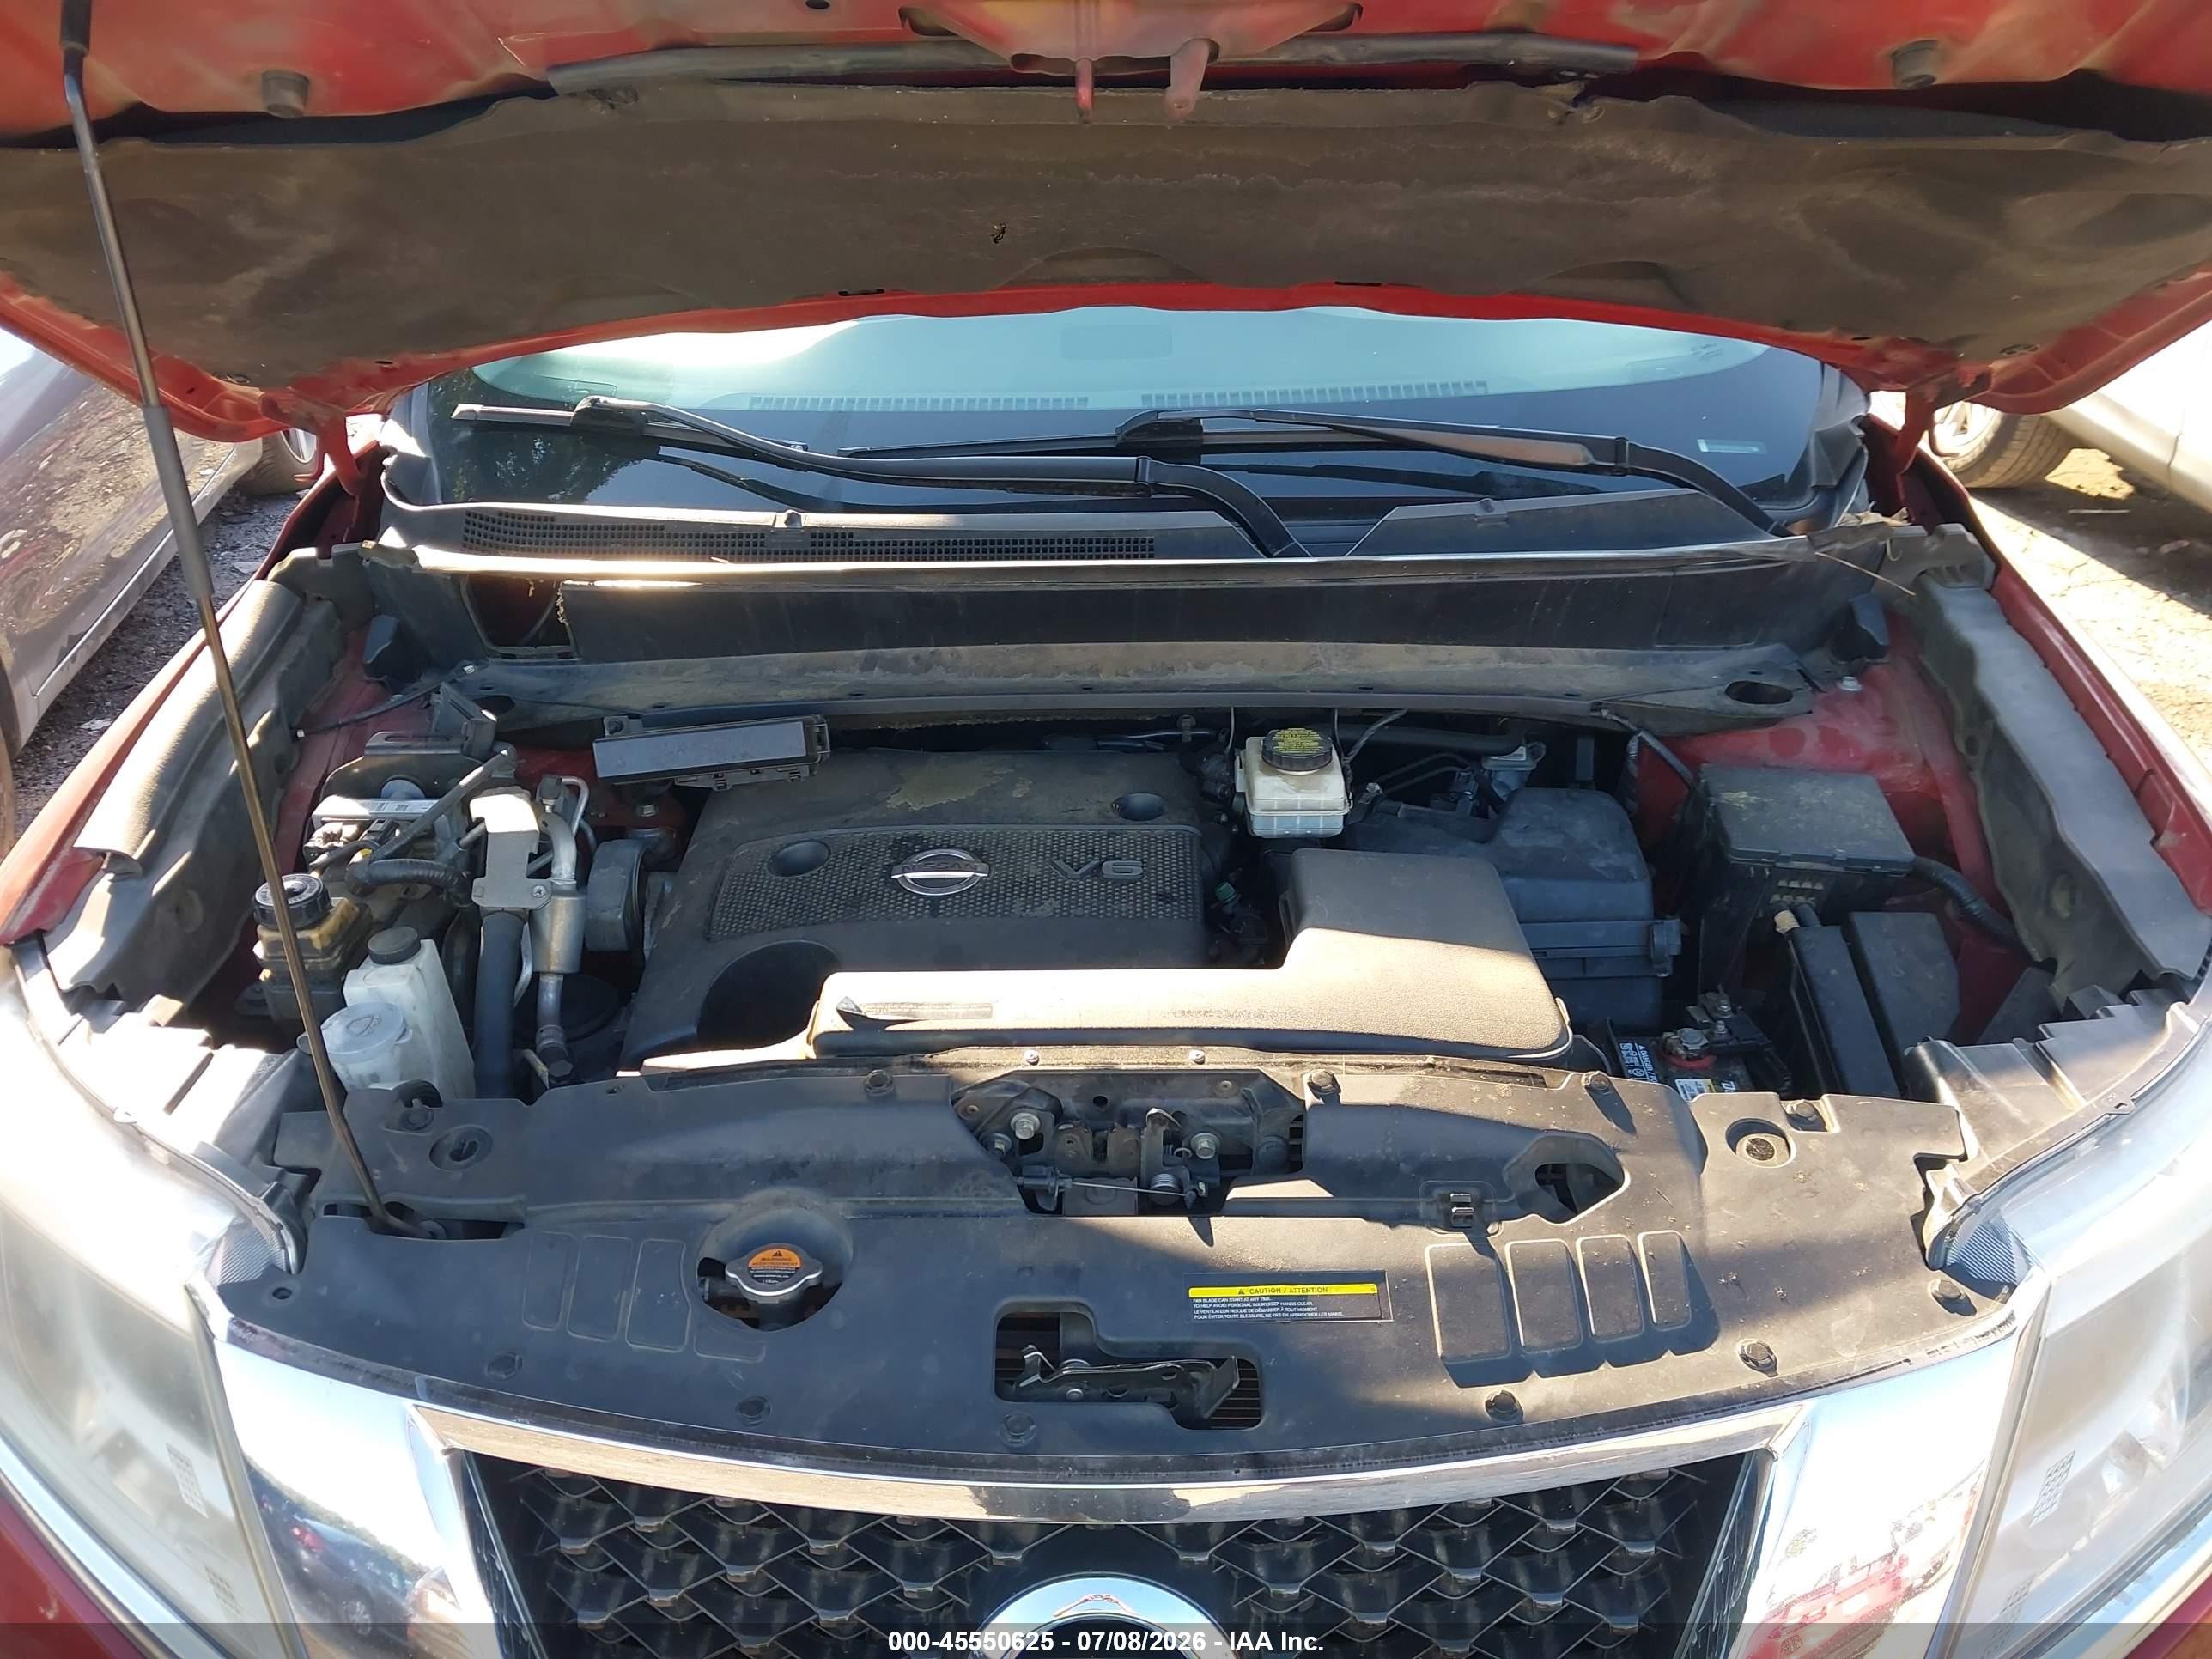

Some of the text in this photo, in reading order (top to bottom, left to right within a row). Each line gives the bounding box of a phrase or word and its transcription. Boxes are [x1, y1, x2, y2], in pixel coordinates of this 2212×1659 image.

[901, 861, 977, 872] NISSAN
[1049, 859, 1145, 880] V6
[1640, 1050, 1654, 1071] DANGER
